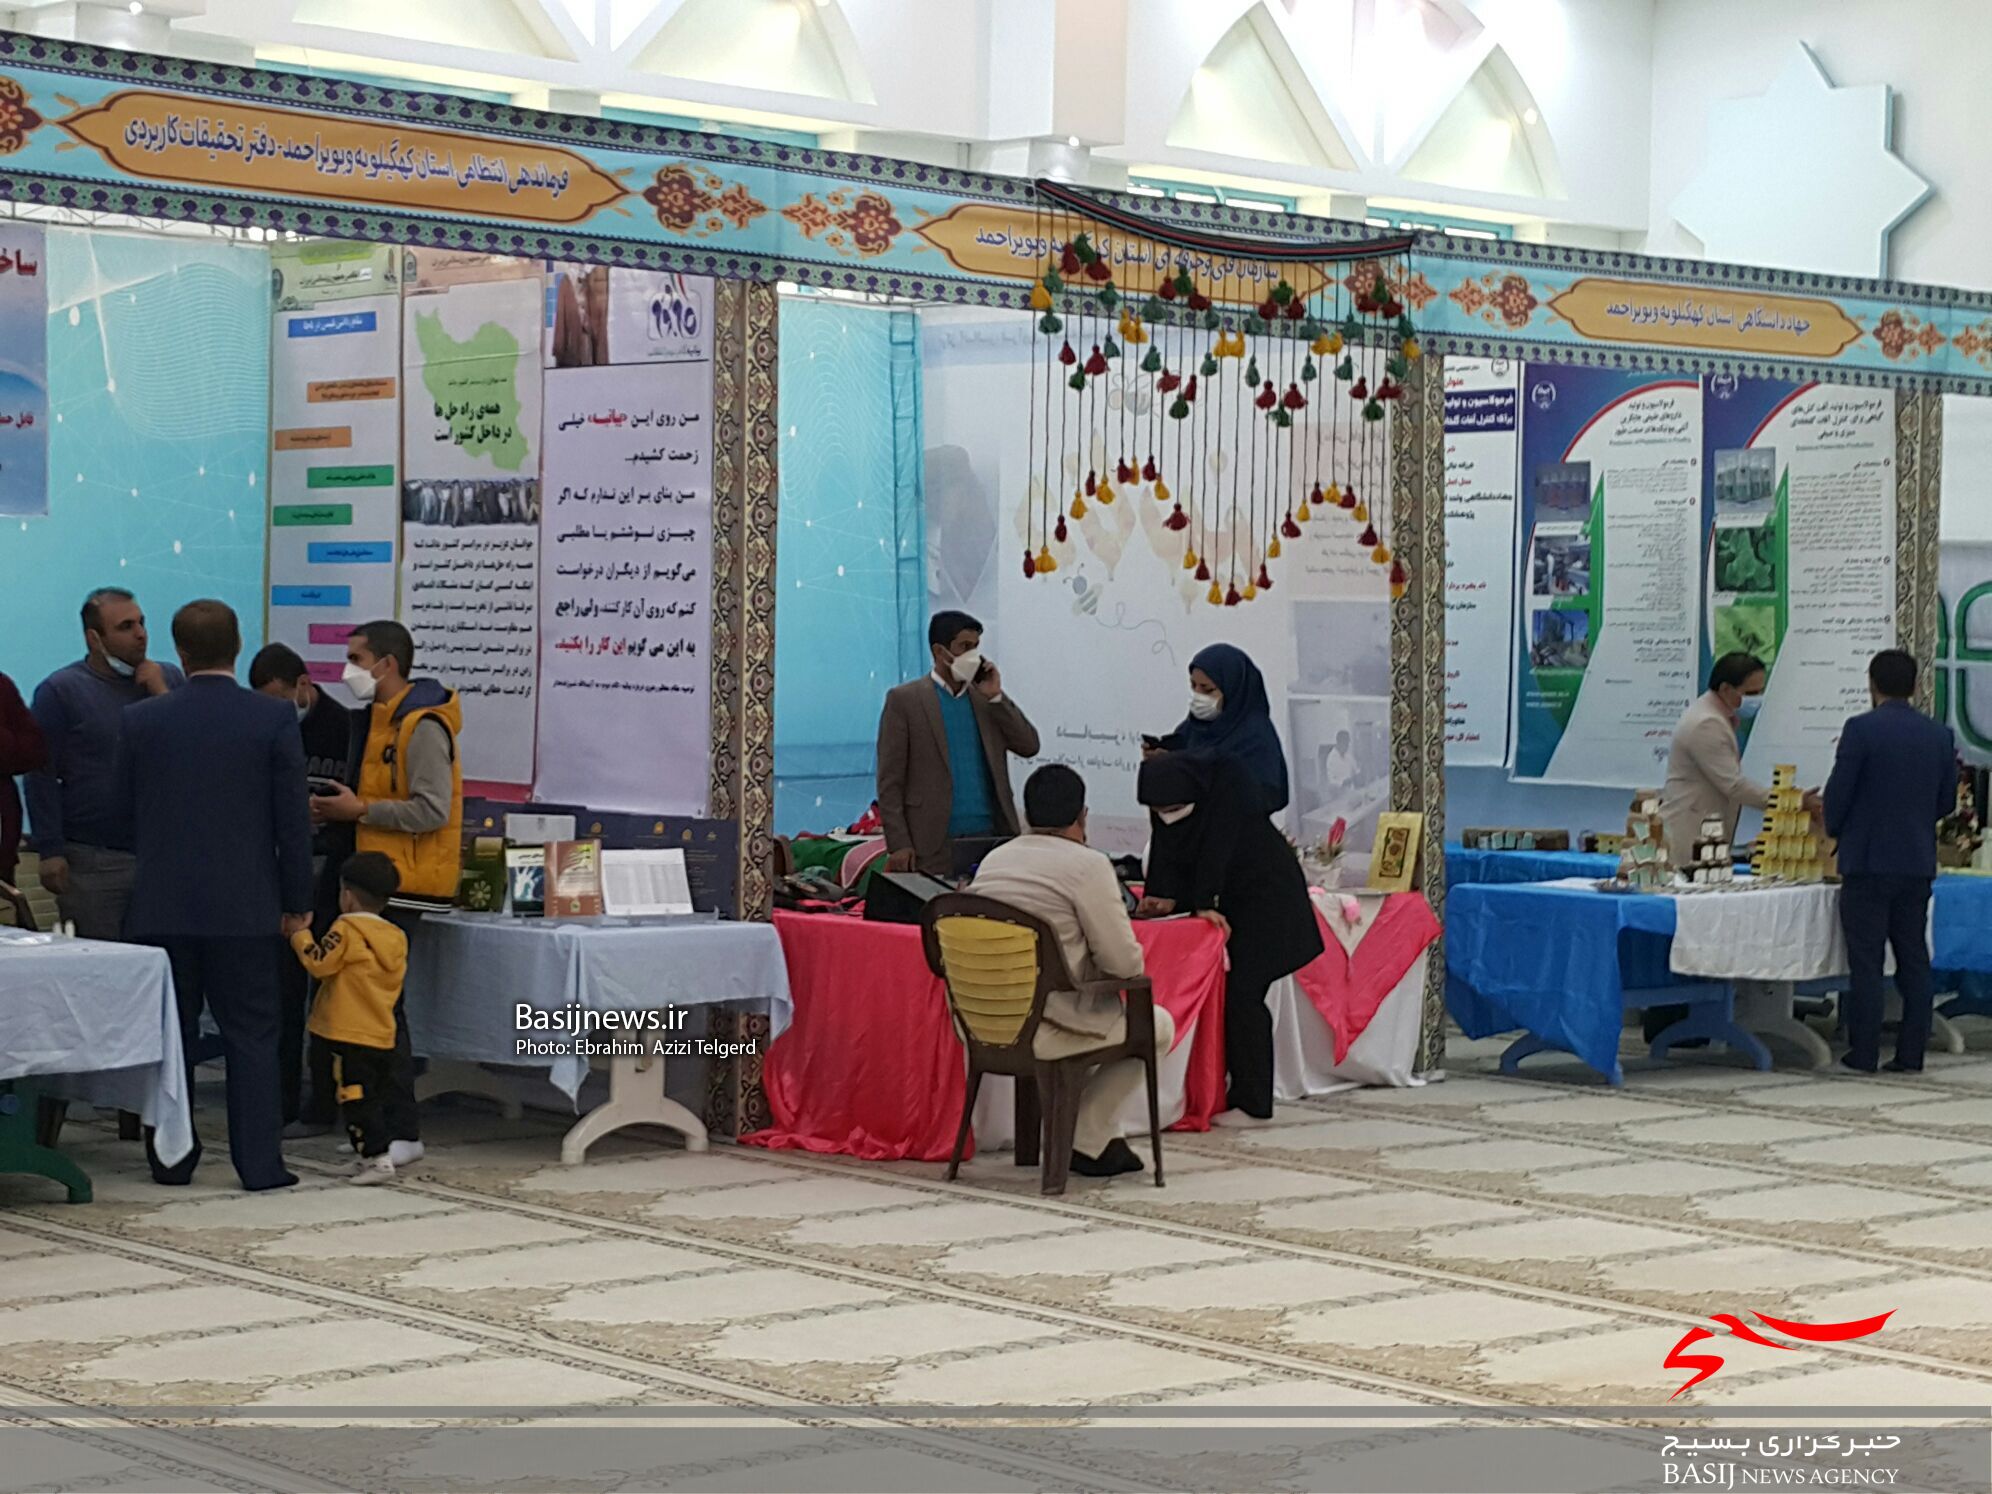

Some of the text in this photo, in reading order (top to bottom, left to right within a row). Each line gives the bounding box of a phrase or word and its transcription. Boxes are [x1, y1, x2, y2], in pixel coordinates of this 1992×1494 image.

[124, 114, 179, 151] کاربردی
[179, 117, 245, 160] تحقیقات
[245, 127, 276, 162] دفتر
[355, 139, 414, 181] کهگیلویه
[416, 148, 455, 178] استان
[456, 153, 508, 187] انتظامی
[509, 164, 569, 197] فرماندهی
[1113, 240, 1151, 265] استان
[1237, 258, 1279, 282] سازمان
[1660, 299, 1704, 327] کهگیلویه
[1707, 305, 1735, 326] استان
[434, 401, 444, 418] ها
[444, 401, 459, 421] حل
[461, 401, 475, 421] راه
[631, 409, 654, 428] این
[656, 412, 677, 427] روی
[558, 412, 585, 431] خیلی
[679, 413, 699, 427] من
[434, 424, 512, 446] در داخل کشور است
[668, 450, 699, 465] زحمت
[557, 485, 696, 506] من بنای بر این ندارم که اگر
[556, 524, 696, 543] چیزی نوشتم یا مطلبی
[606, 562, 640, 581] دیگران
[642, 562, 651, 581] از
[555, 597, 580, 617] راجع
[581, 597, 599, 618] ولی
[633, 597, 645, 619] آن
[646, 605, 665, 619] روی
[666, 601, 678, 615] که
[678, 601, 697, 618] کنم
[585, 635, 594, 655] را
[596, 635, 611, 656] کار
[612, 636, 627, 656] این
[627, 637, 647, 657] گویم
[649, 643, 665, 657] می
[666, 638, 684, 658] این
[686, 641, 697, 658] به
